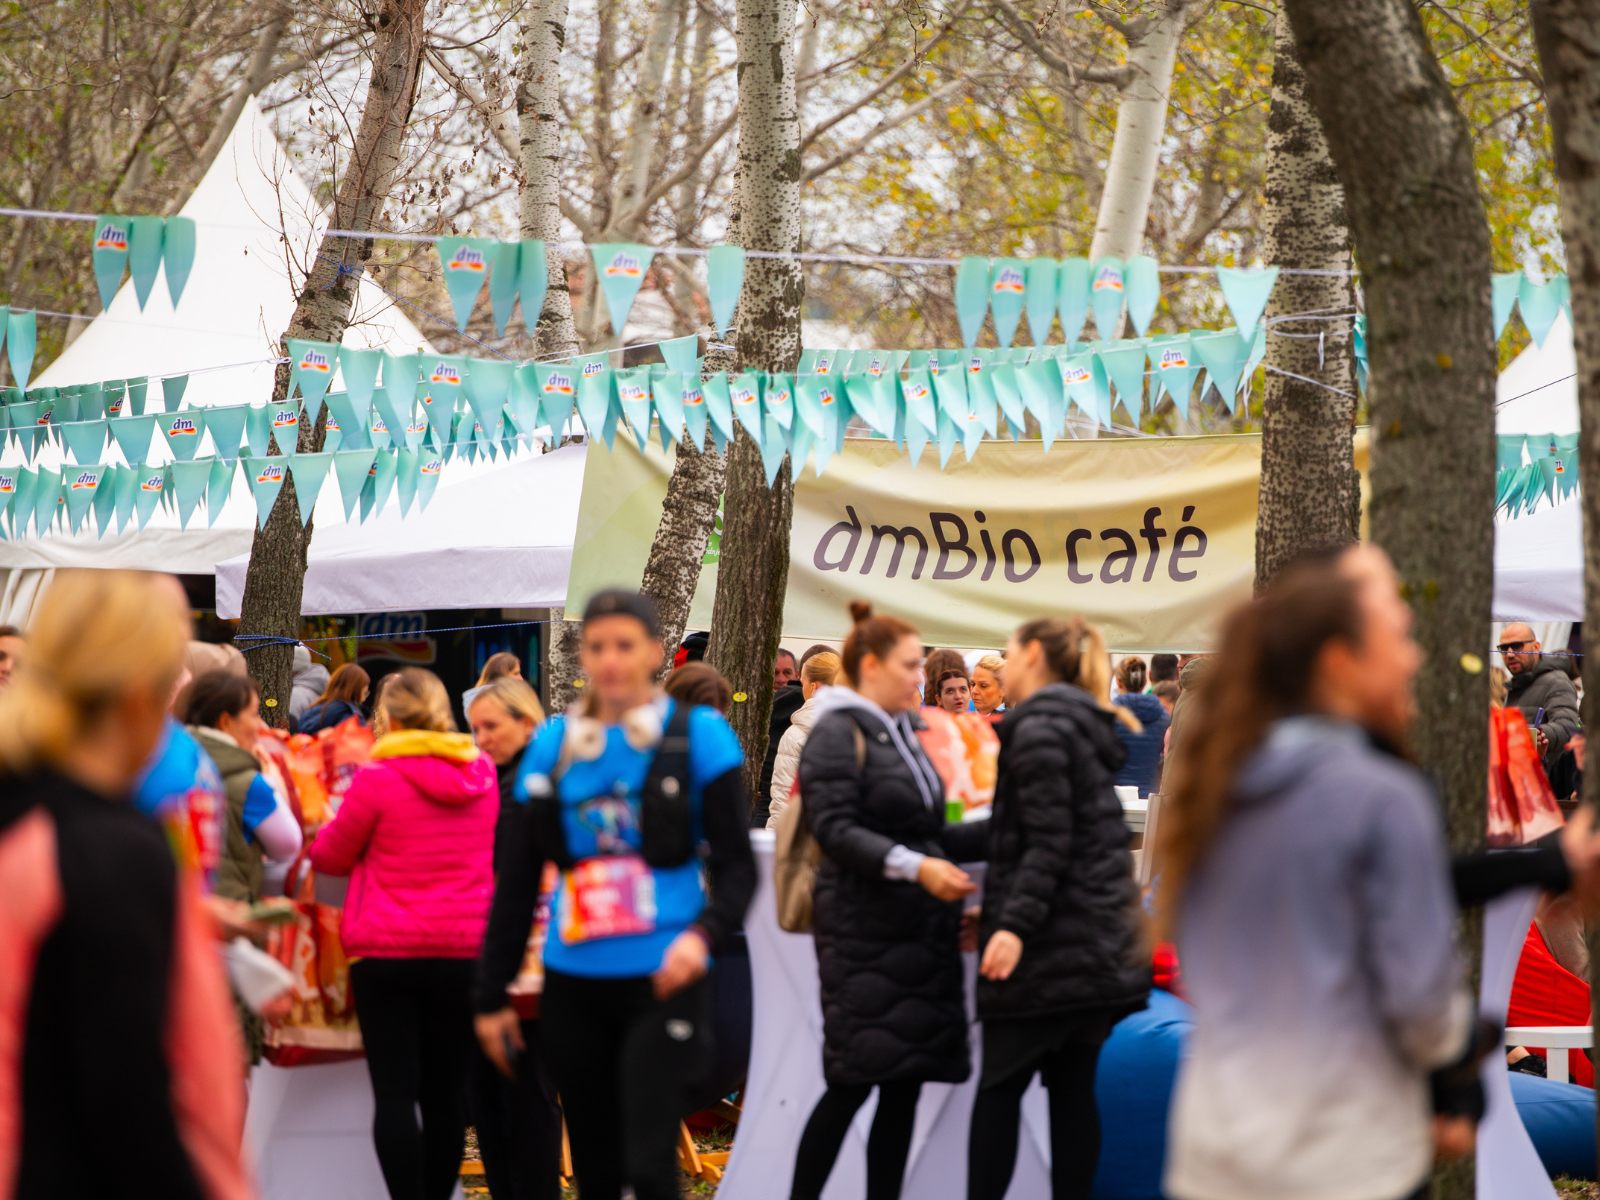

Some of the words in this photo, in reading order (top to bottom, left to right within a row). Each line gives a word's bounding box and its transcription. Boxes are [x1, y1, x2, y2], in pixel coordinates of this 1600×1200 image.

[101, 225, 125, 241] dm
[456, 248, 481, 262] dm
[613, 255, 637, 268] dm
[1001, 268, 1021, 282] dm
[1100, 267, 1120, 280] dm
[305, 350, 326, 363] dm
[1163, 350, 1182, 361] dm
[436, 363, 456, 376] dm
[584, 363, 602, 374] dm
[549, 373, 569, 386] dm
[276, 411, 294, 422] dm
[173, 418, 192, 430] dm
[77, 472, 96, 483] dm
[263, 465, 281, 477] dm
[813, 505, 1042, 584] dmBio
[1064, 505, 1208, 584] café
[363, 612, 424, 640] dm
